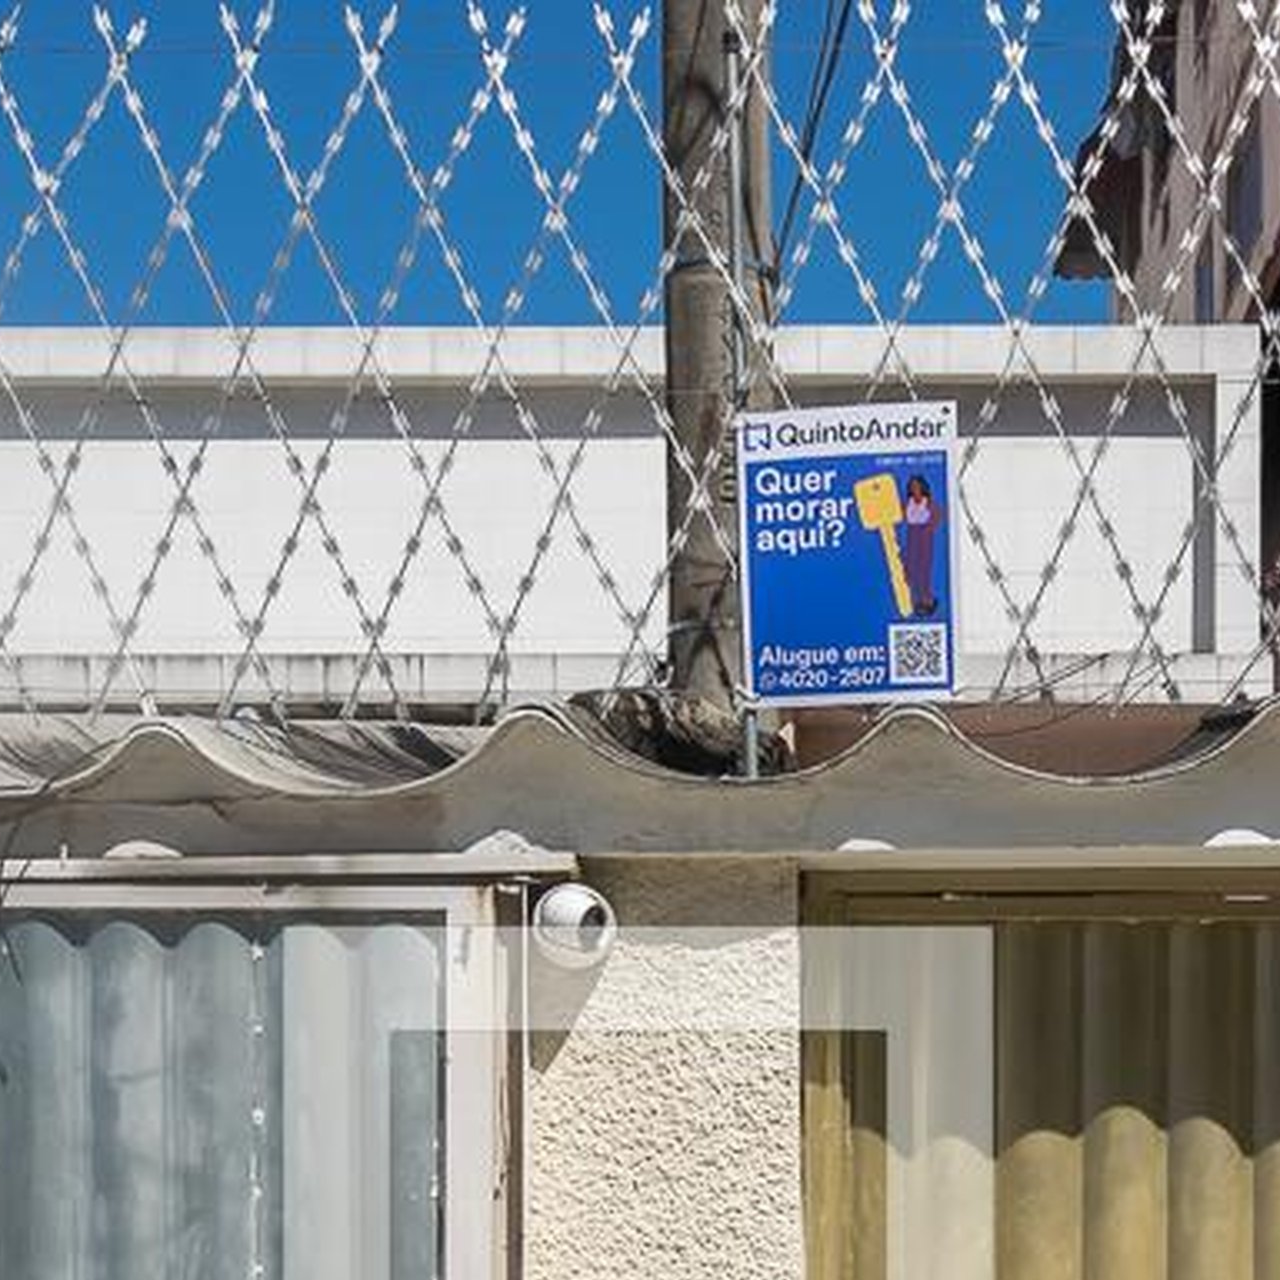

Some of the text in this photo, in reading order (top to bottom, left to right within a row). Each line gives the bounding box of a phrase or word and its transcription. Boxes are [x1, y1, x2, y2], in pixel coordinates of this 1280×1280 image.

[775, 417, 947, 448] QuintoAndar
[755, 467, 836, 495] Quer
[755, 497, 854, 523] morar
[756, 520, 845, 556] aqui?
[759, 645, 886, 669] Alugue em:
